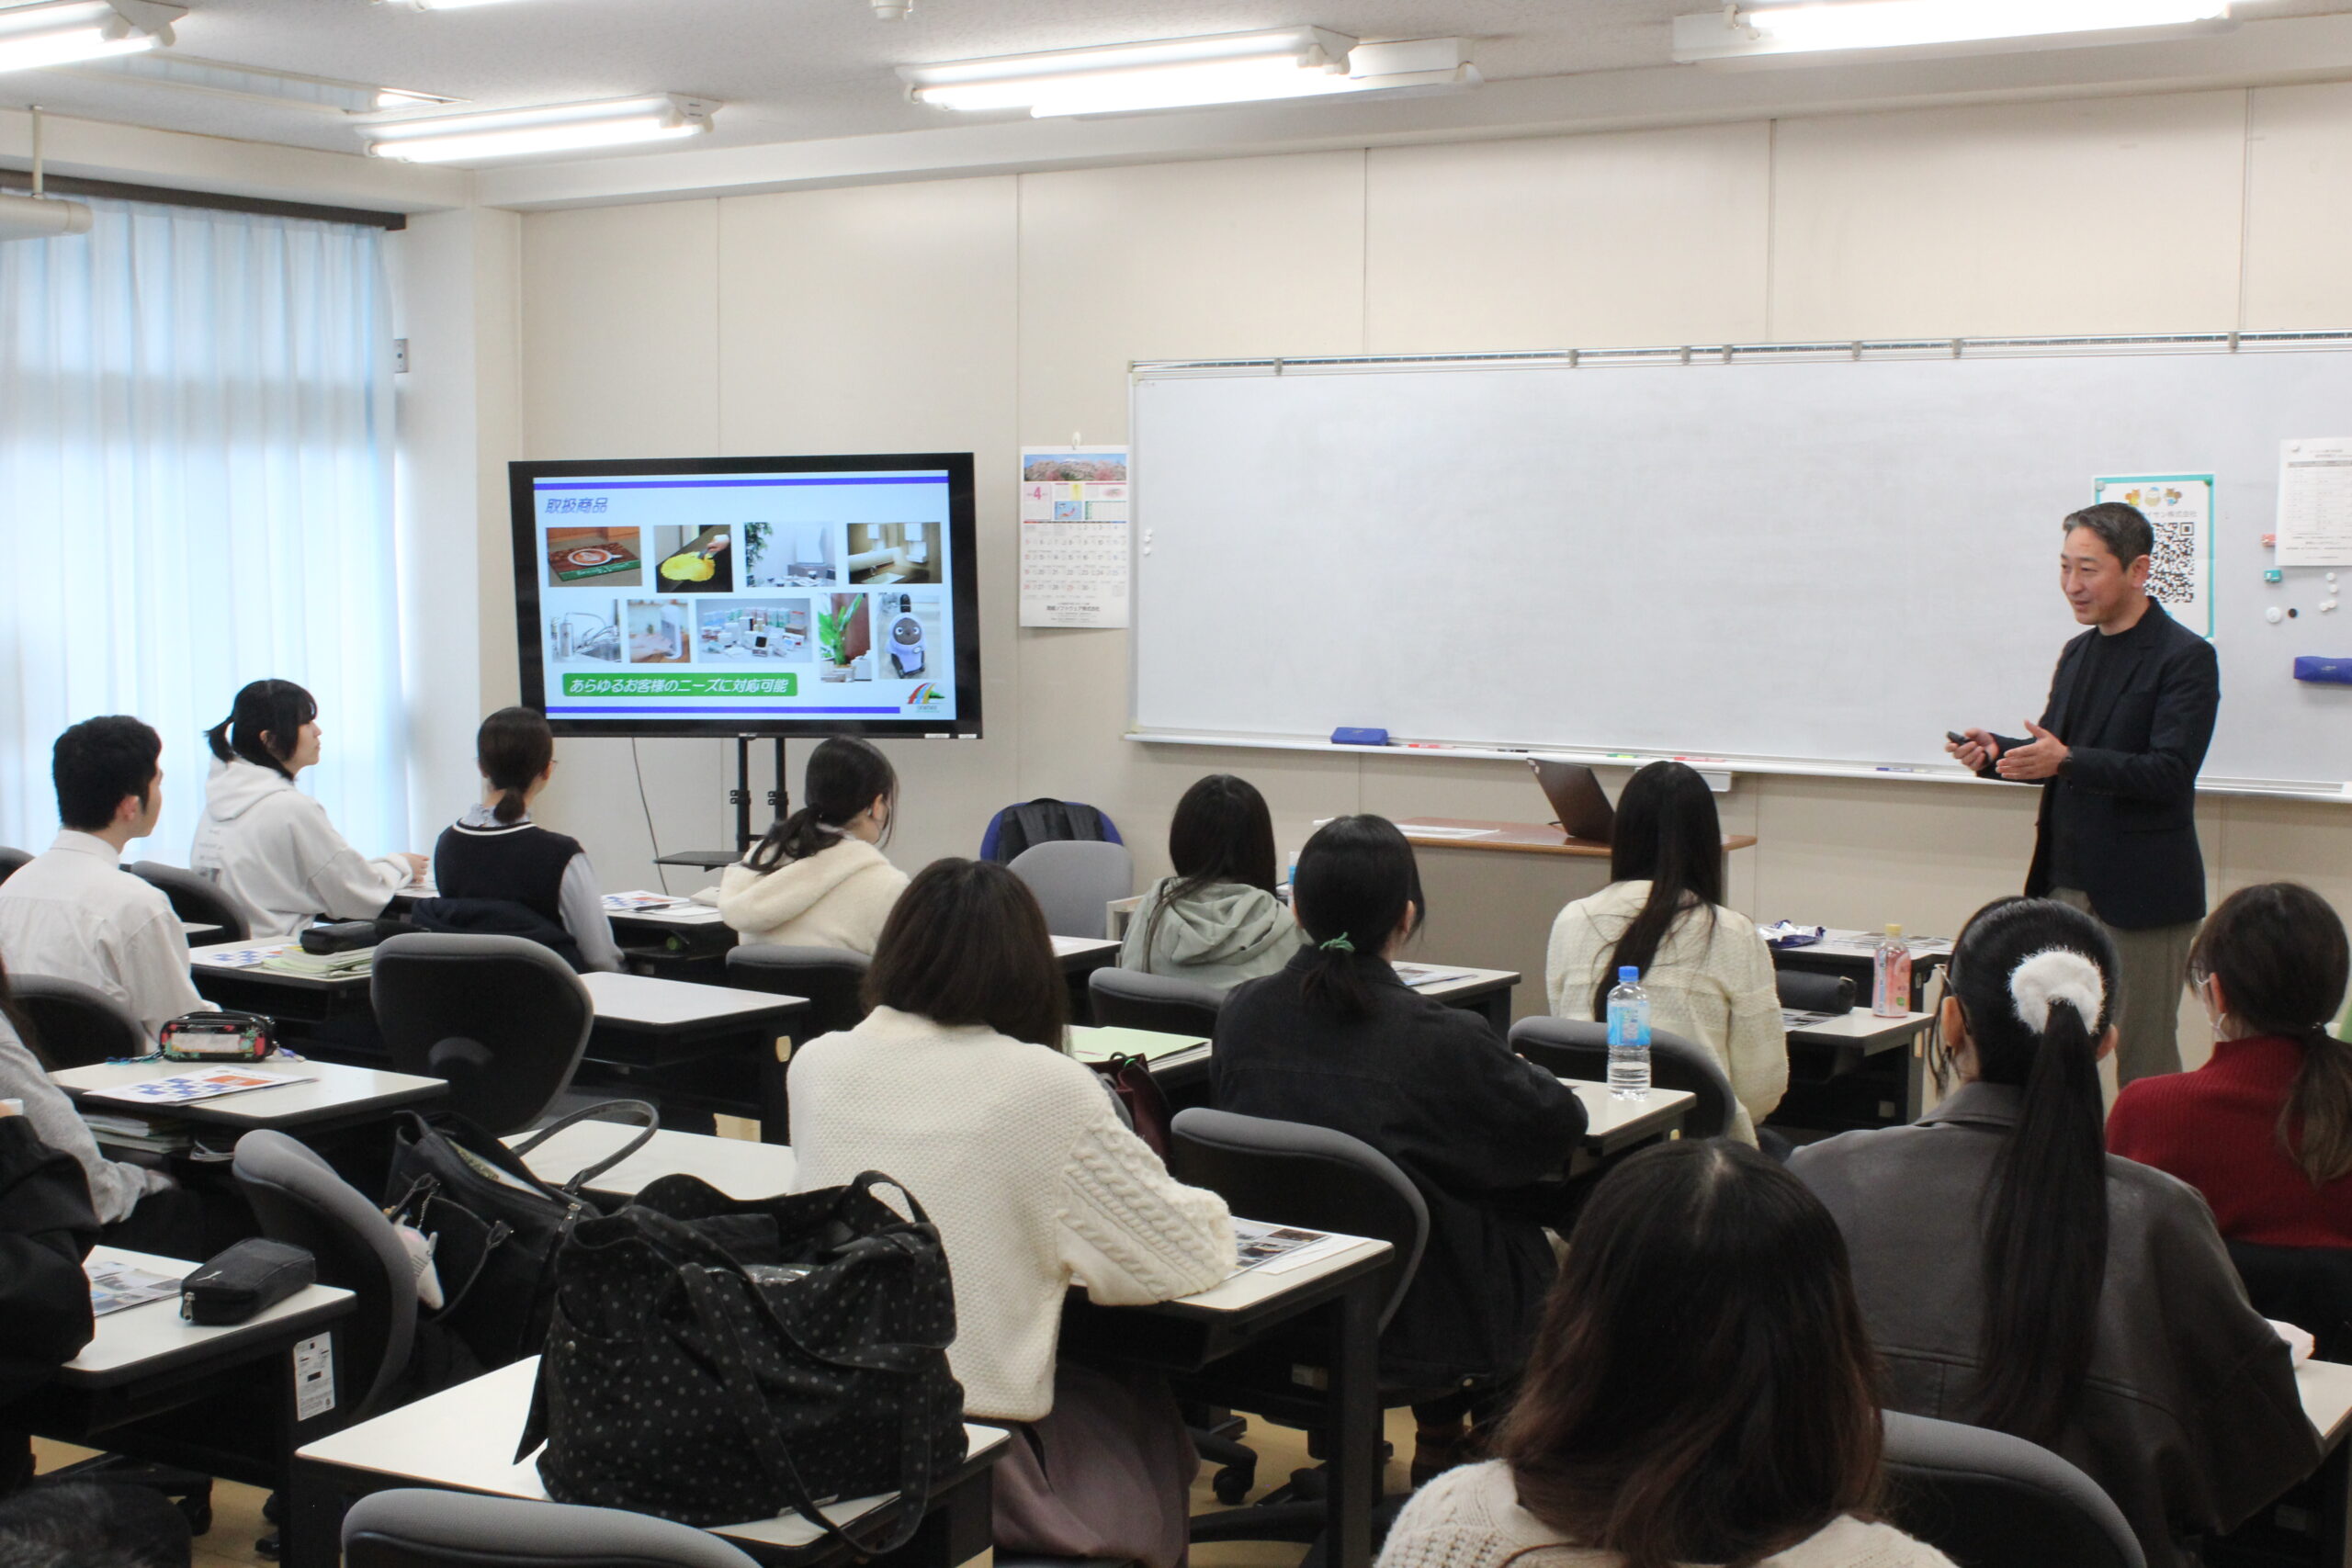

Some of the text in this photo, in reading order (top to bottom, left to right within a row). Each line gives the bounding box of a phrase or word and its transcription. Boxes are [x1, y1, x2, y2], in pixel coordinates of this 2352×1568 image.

[1034, 487, 1042, 500] 4
[545, 497, 608, 514] 取扱商品
[570, 678, 789, 694] あらゆるお客様のニーズに対応可能
